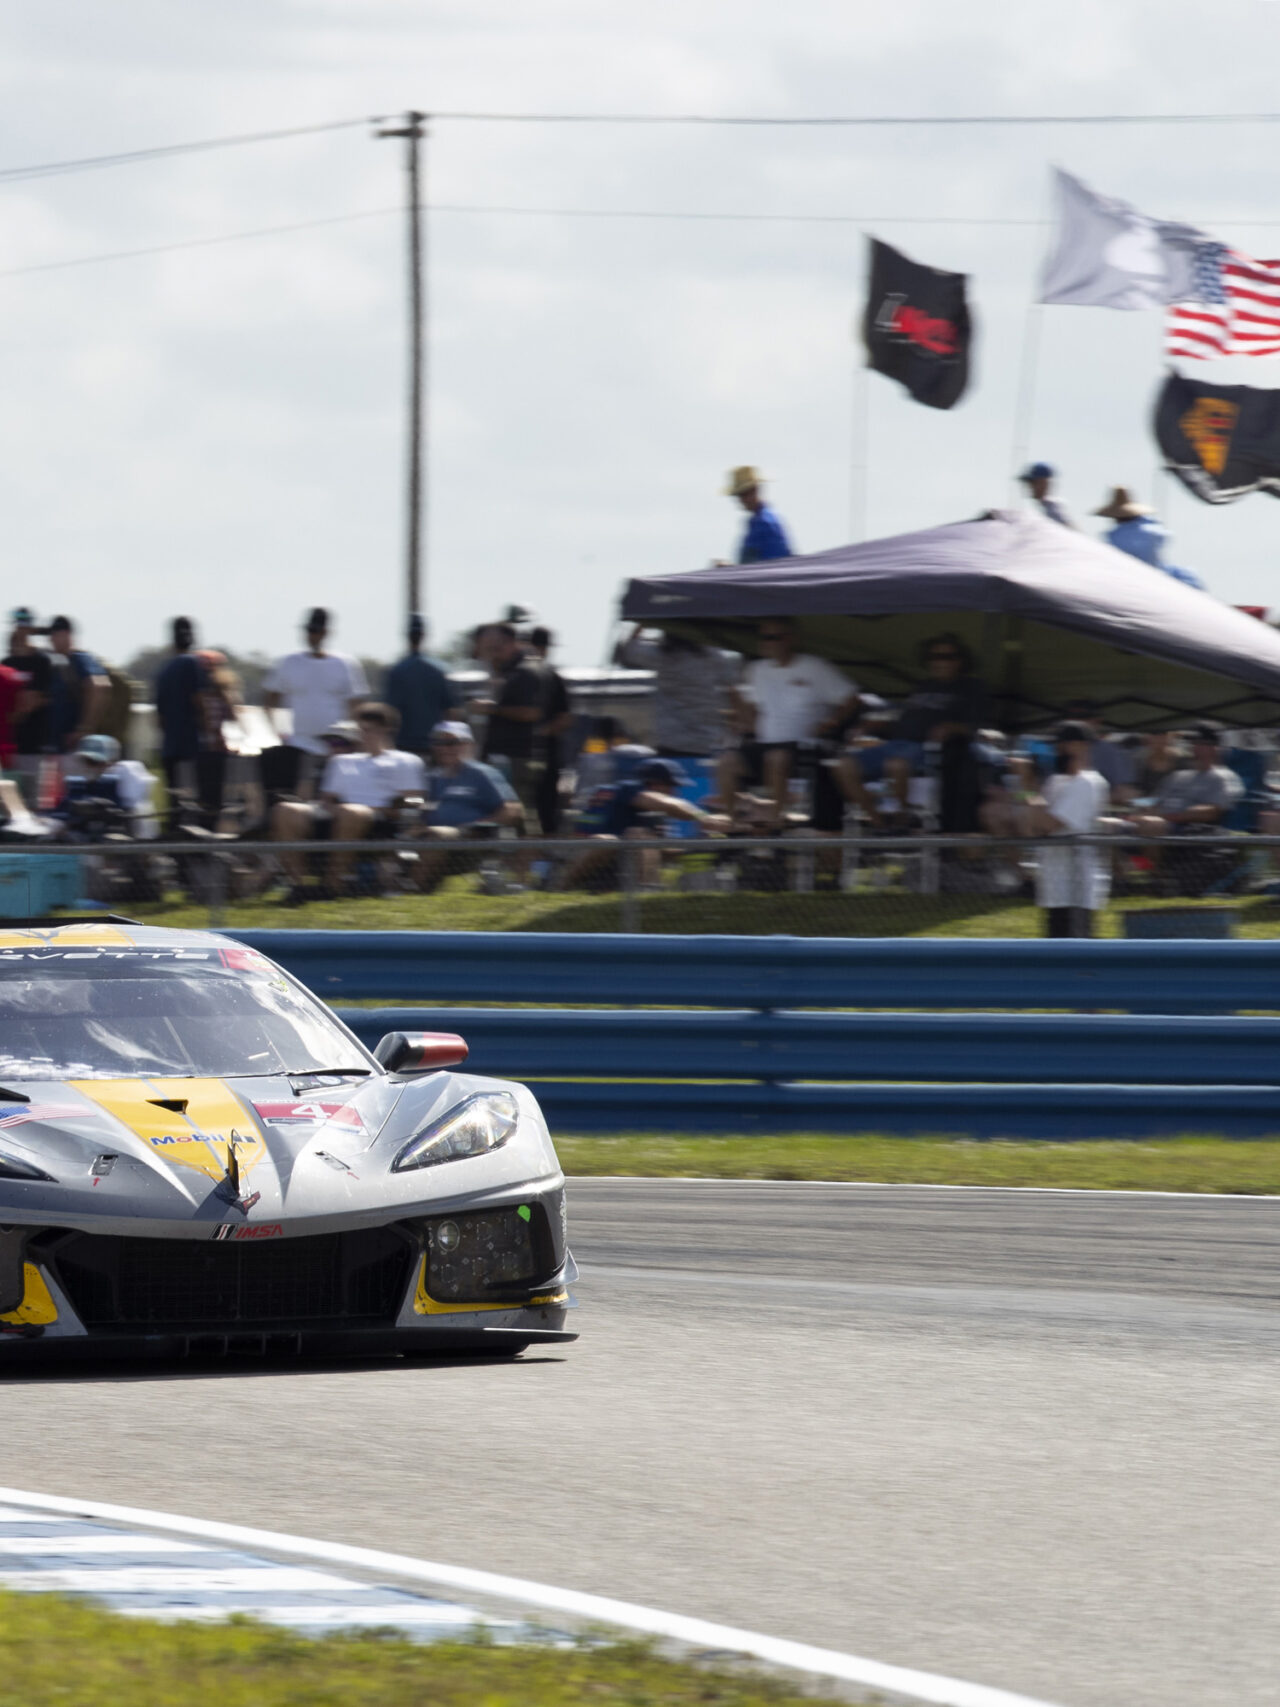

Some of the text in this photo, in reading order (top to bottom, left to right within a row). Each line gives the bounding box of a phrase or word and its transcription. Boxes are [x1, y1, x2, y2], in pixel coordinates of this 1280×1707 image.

[291, 1104, 332, 1118] 4
[150, 1134, 225, 1145] Mobil
[235, 1224, 284, 1239] IMSA
